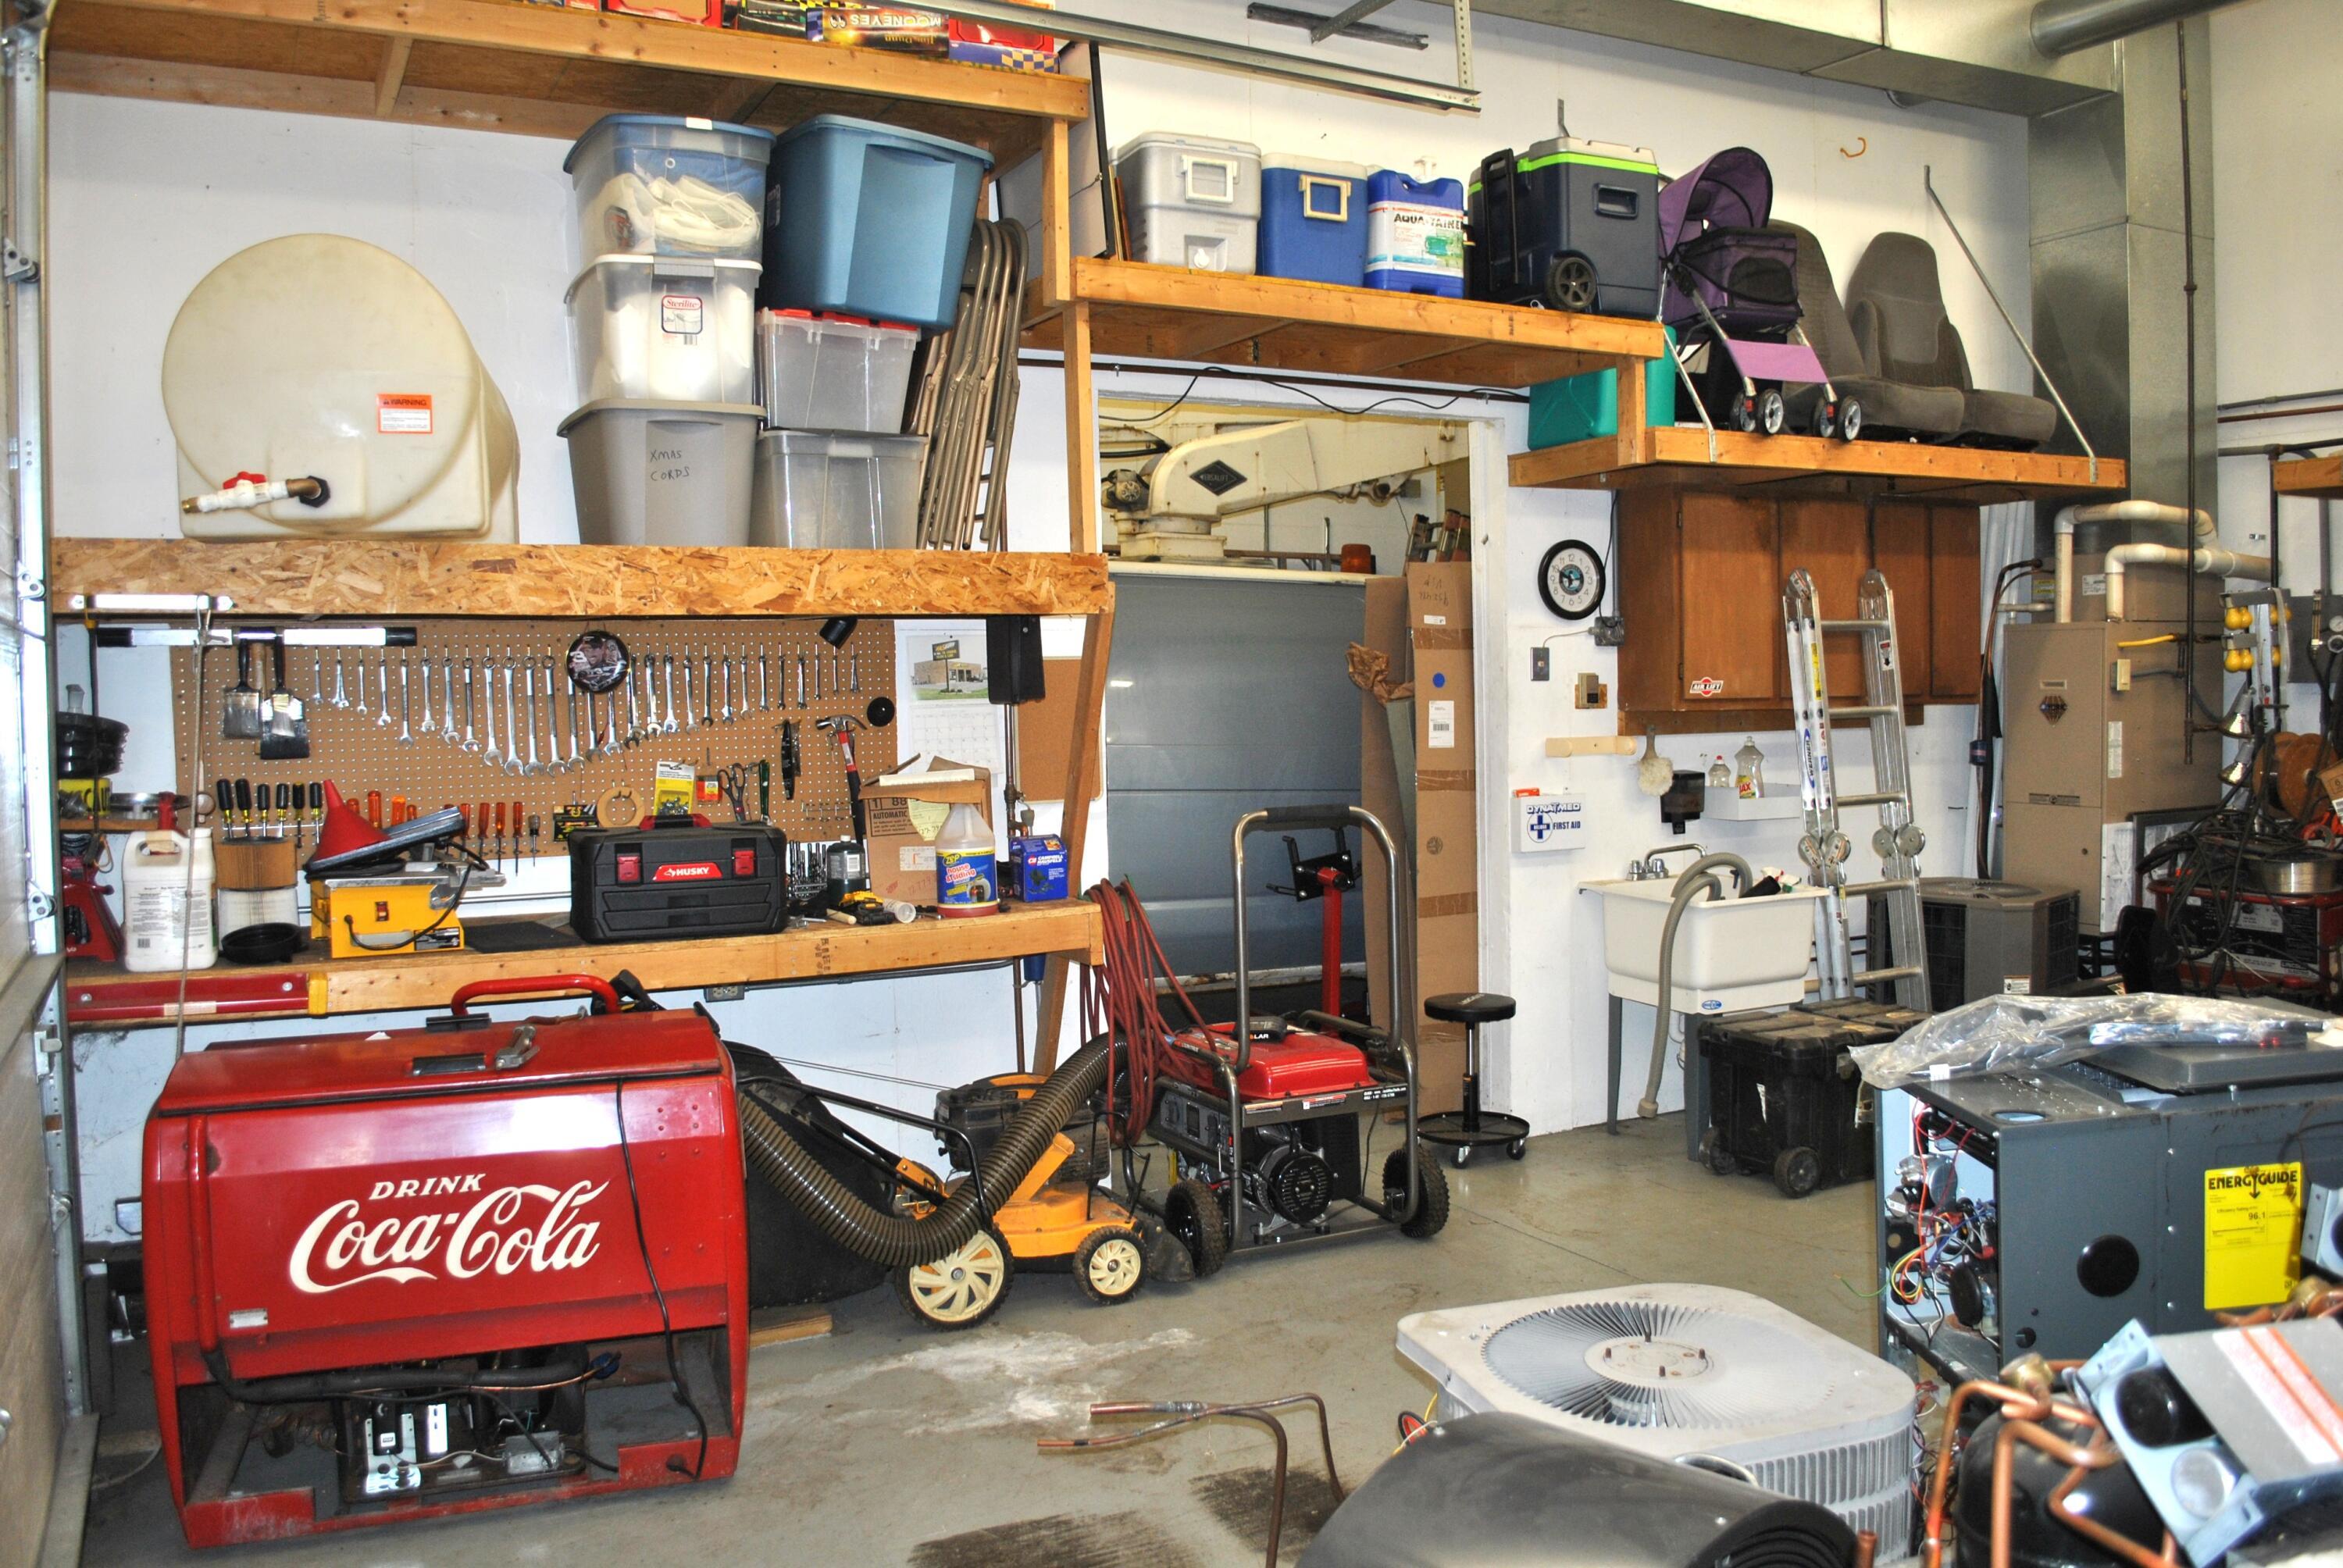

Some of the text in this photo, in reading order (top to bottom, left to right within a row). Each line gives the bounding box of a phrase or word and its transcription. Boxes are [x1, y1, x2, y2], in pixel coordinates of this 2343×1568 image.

[850, 13, 941, 28] MOONEYES
[666, 298, 697, 308] Sterilite
[650, 449, 682, 462] XMAS
[651, 466, 690, 481] CORDS
[1568, 553, 1575, 562] 12
[1585, 565, 1590, 575] 2
[1588, 576, 1592, 585] 3
[1553, 586, 1558, 595] 8
[1561, 594, 1566, 604] 7
[1578, 595, 1582, 604] 5
[570, 650, 588, 662] 3
[1806, 739, 1814, 777] WERNER
[1739, 783, 1752, 792] JAX
[873, 810, 908, 819] AUTOMATIC
[1553, 821, 1570, 830] FIRST
[1571, 821, 1581, 829] AID
[676, 867, 709, 875] HUSKY
[947, 864, 969, 874] house
[369, 1173, 487, 1200] DRINK
[2248, 1212, 2266, 1221] 96.1
[289, 1179, 610, 1293] Coca-Cola
